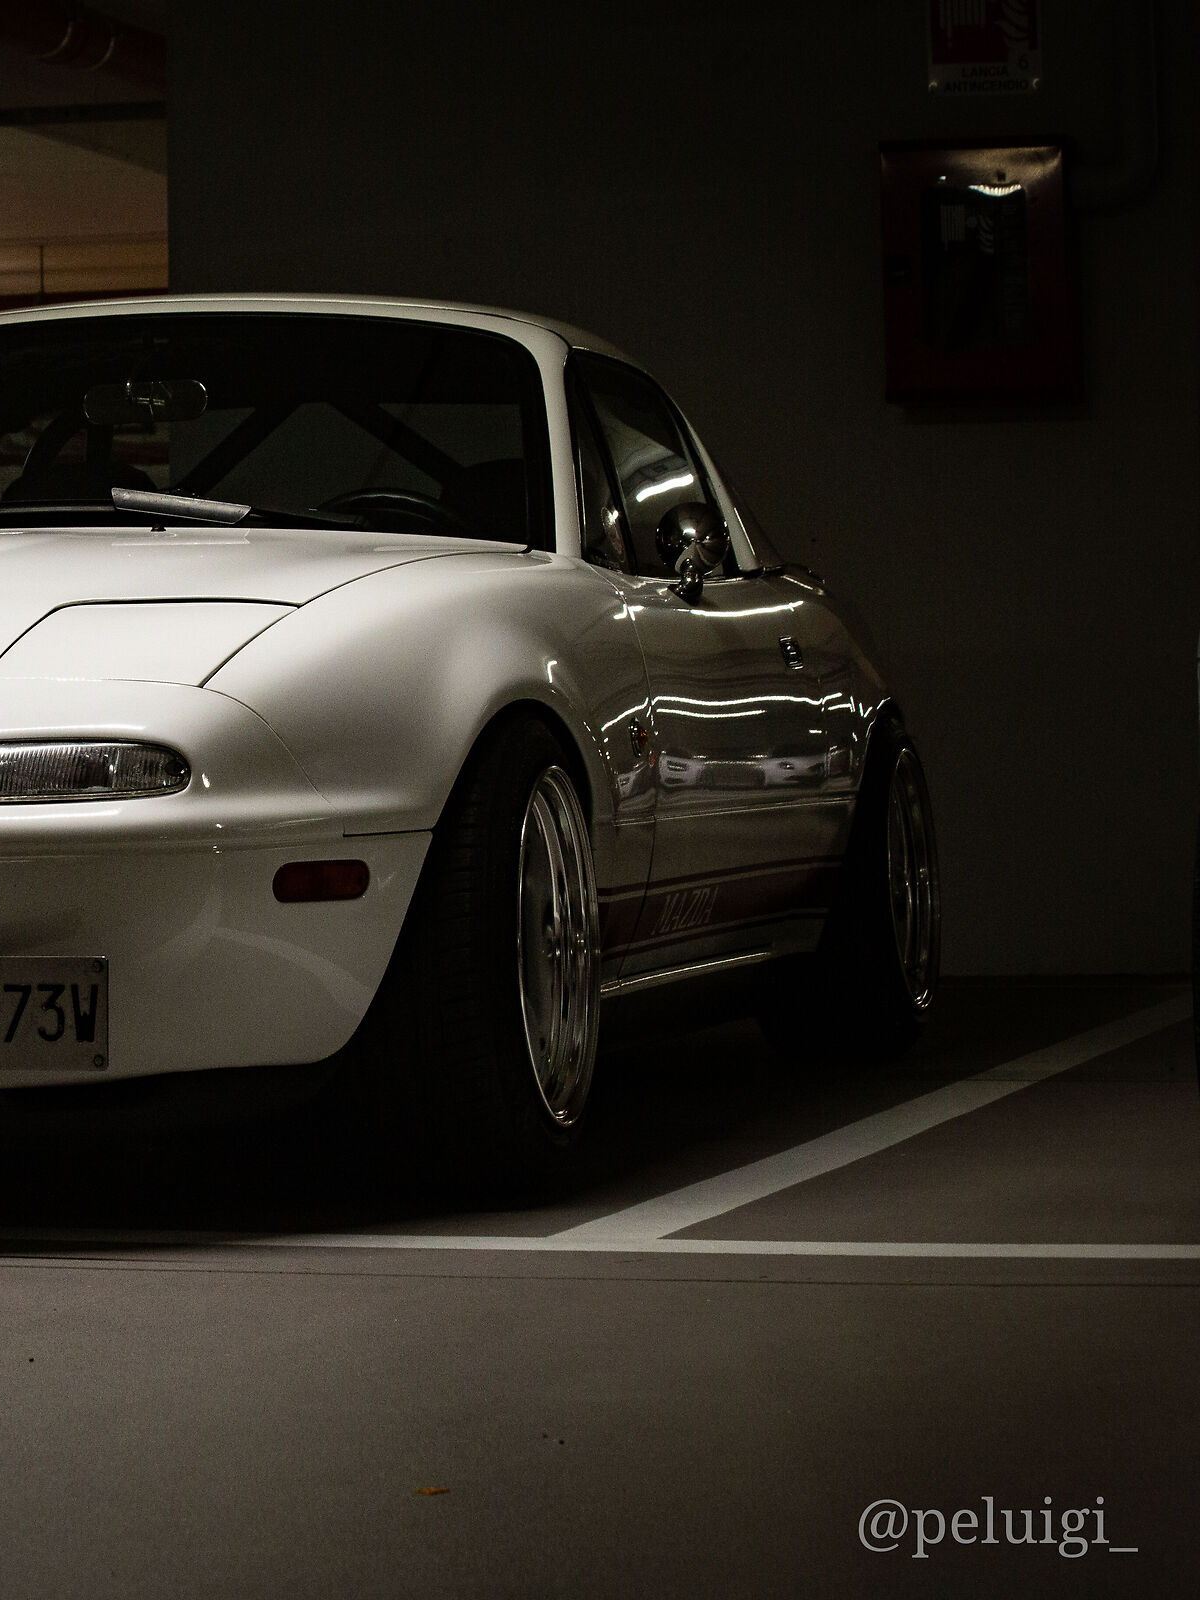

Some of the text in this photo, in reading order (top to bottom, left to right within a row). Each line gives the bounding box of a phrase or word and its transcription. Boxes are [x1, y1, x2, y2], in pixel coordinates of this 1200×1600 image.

[961, 65, 1009, 77] LANCIA
[944, 79, 1029, 92] ANTINCENDIO
[651, 886, 719, 936] MAZDA
